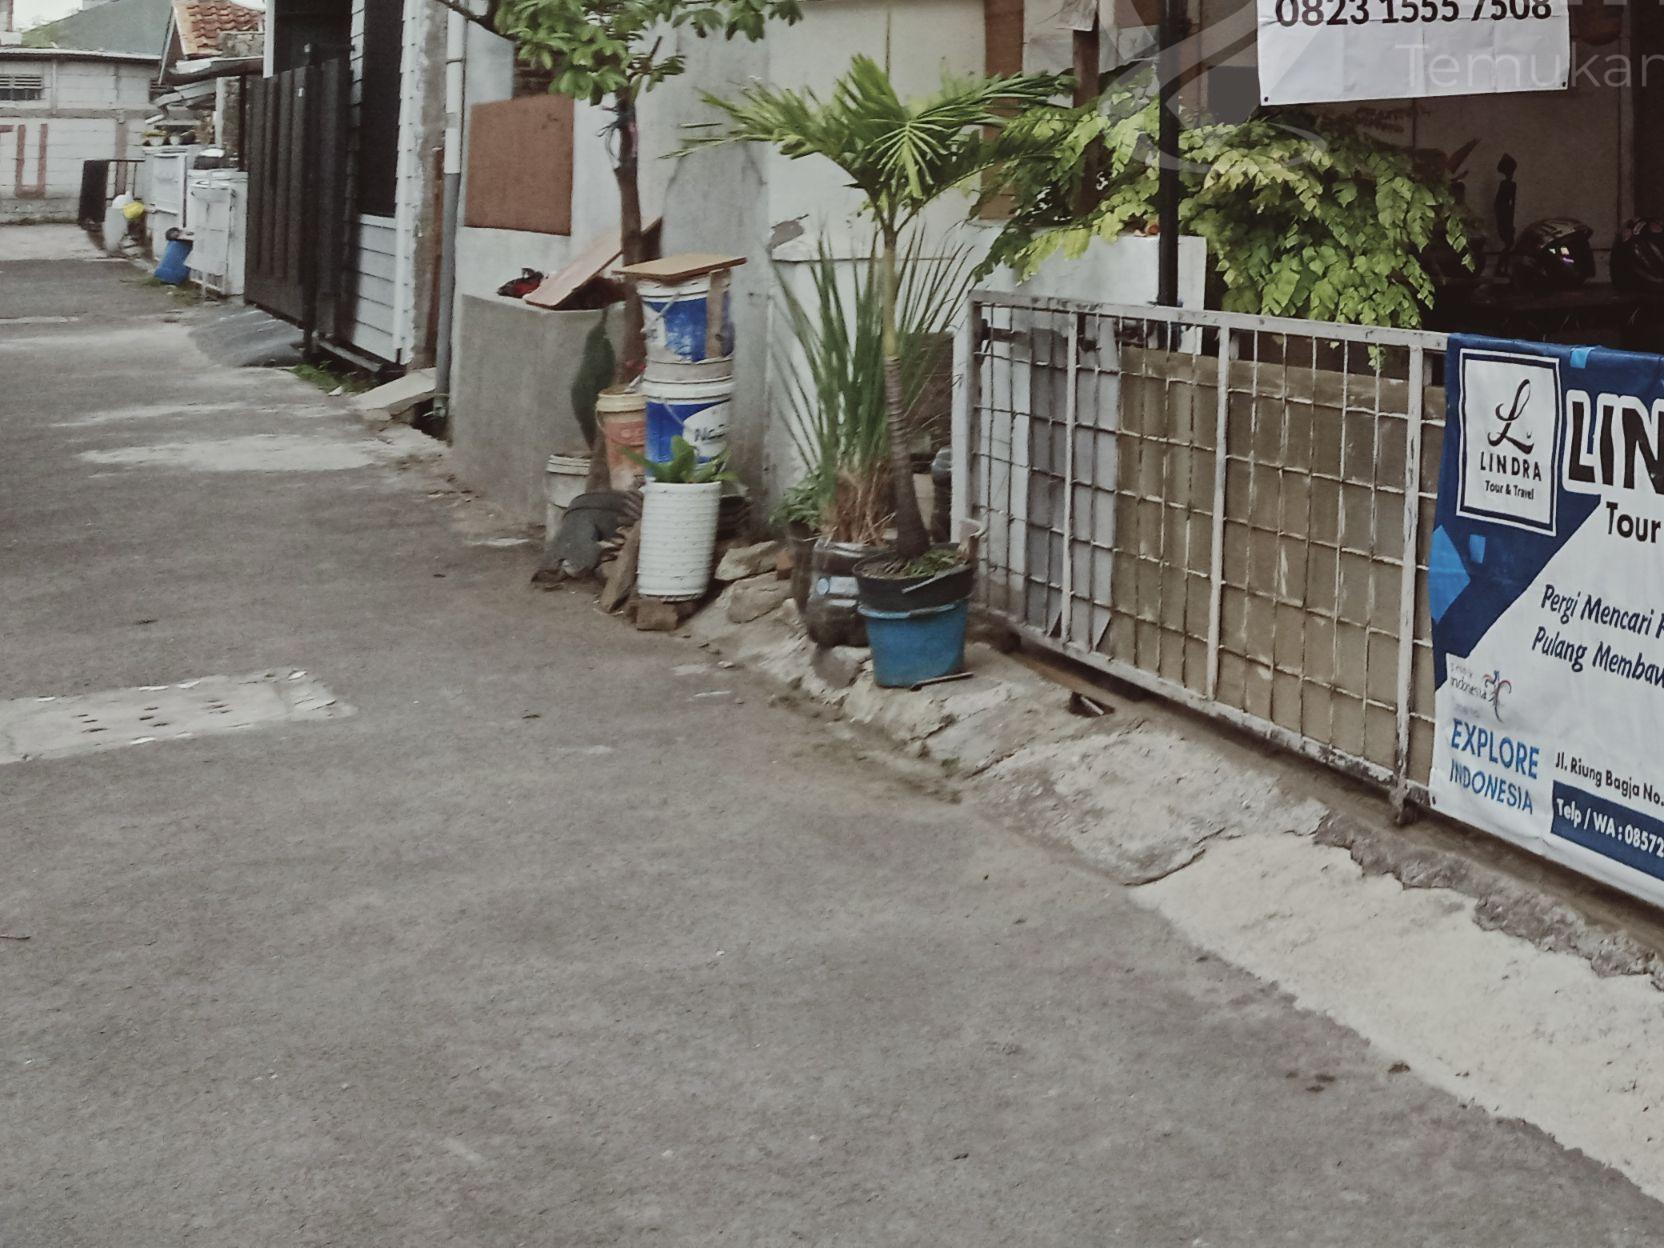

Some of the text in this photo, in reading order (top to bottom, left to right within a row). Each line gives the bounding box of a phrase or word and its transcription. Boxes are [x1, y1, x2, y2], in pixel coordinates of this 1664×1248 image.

[1480, 451, 1541, 481] LINDRA
[1485, 480, 1534, 500] Tour & Travel
[1606, 501, 1661, 543] Tour
[1541, 584, 1581, 624] Pergi
[1580, 594, 1654, 636] Mencari
[1531, 626, 1587, 673] Pulang
[1451, 717, 1540, 780] EXPLORE
[1450, 759, 1534, 815] INDONESIA
[1555, 752, 1568, 771] Jl.
[1571, 756, 1602, 787] Riung
[1605, 770, 1640, 800] Bagja
[1643, 783, 1664, 807] No.
[1556, 798, 1582, 829] Telp
